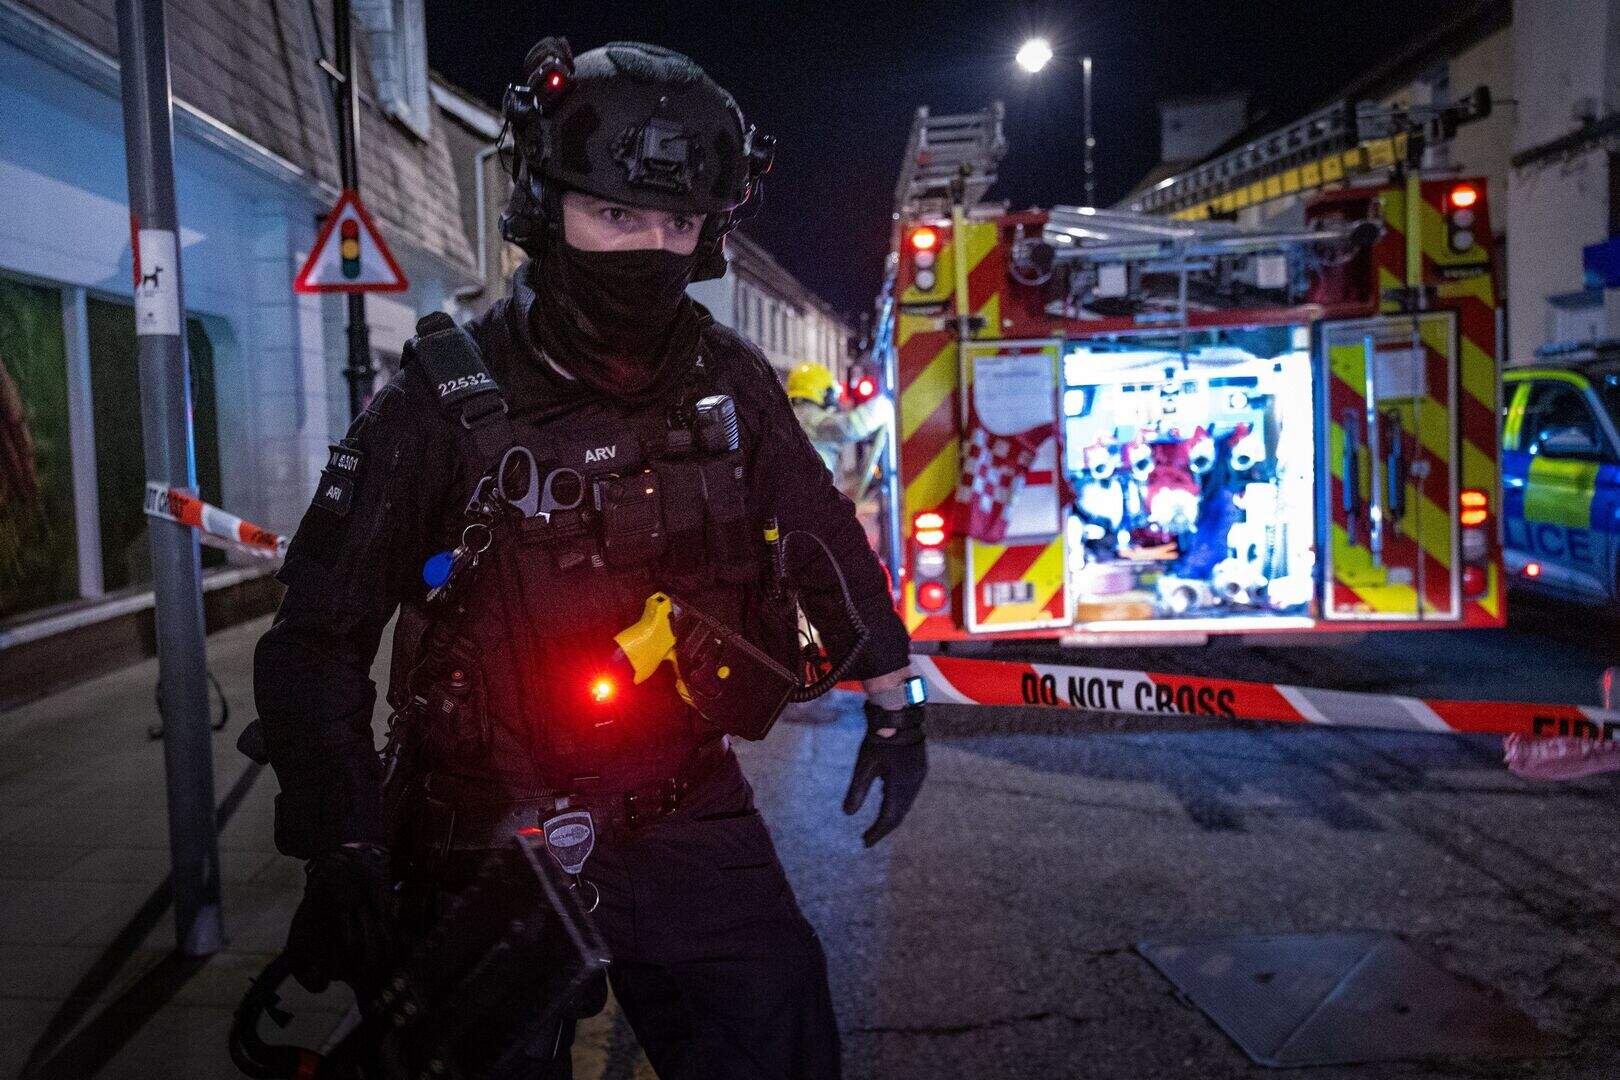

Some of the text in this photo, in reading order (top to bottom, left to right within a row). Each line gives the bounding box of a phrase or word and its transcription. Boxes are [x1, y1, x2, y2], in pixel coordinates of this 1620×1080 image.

[438, 372, 491, 397] 22532
[585, 445, 616, 463] ARV
[1021, 673, 1236, 718] DO NOT CROSS
